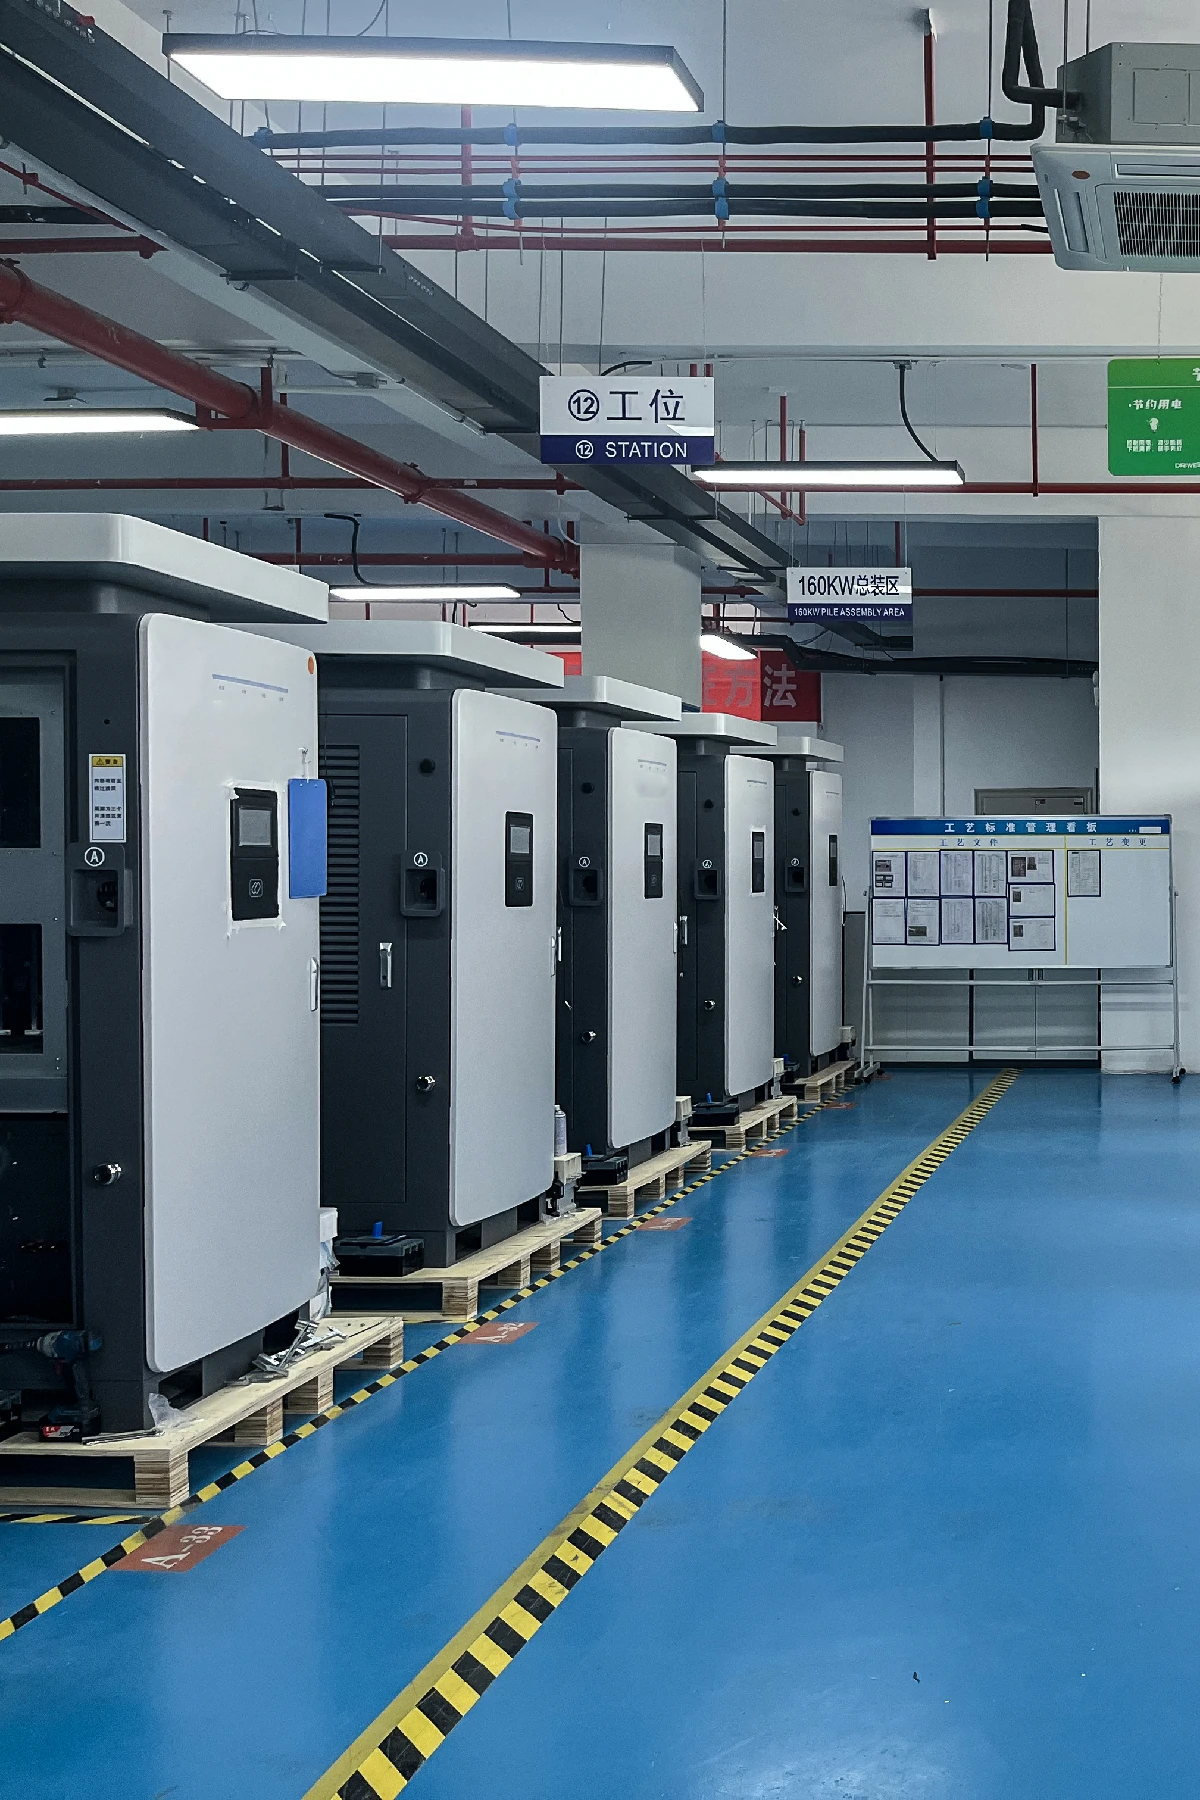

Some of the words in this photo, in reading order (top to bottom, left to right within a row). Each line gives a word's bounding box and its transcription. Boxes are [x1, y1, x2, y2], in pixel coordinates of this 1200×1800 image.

[1132, 399, 1182, 410] 节约用电
[605, 442, 687, 458] STATION
[799, 574, 899, 596] 160KW总装区
[794, 607, 821, 617] 160KW
[821, 607, 839, 617] PILE
[840, 607, 882, 617] ASSEMBLY
[883, 607, 905, 617] AREA
[944, 822, 1097, 833] 工艺标准管理看板
[940, 837, 998, 847] 工艺文件
[1089, 837, 1147, 847] 工艺变更
[141, 1526, 223, 1570] A-33
